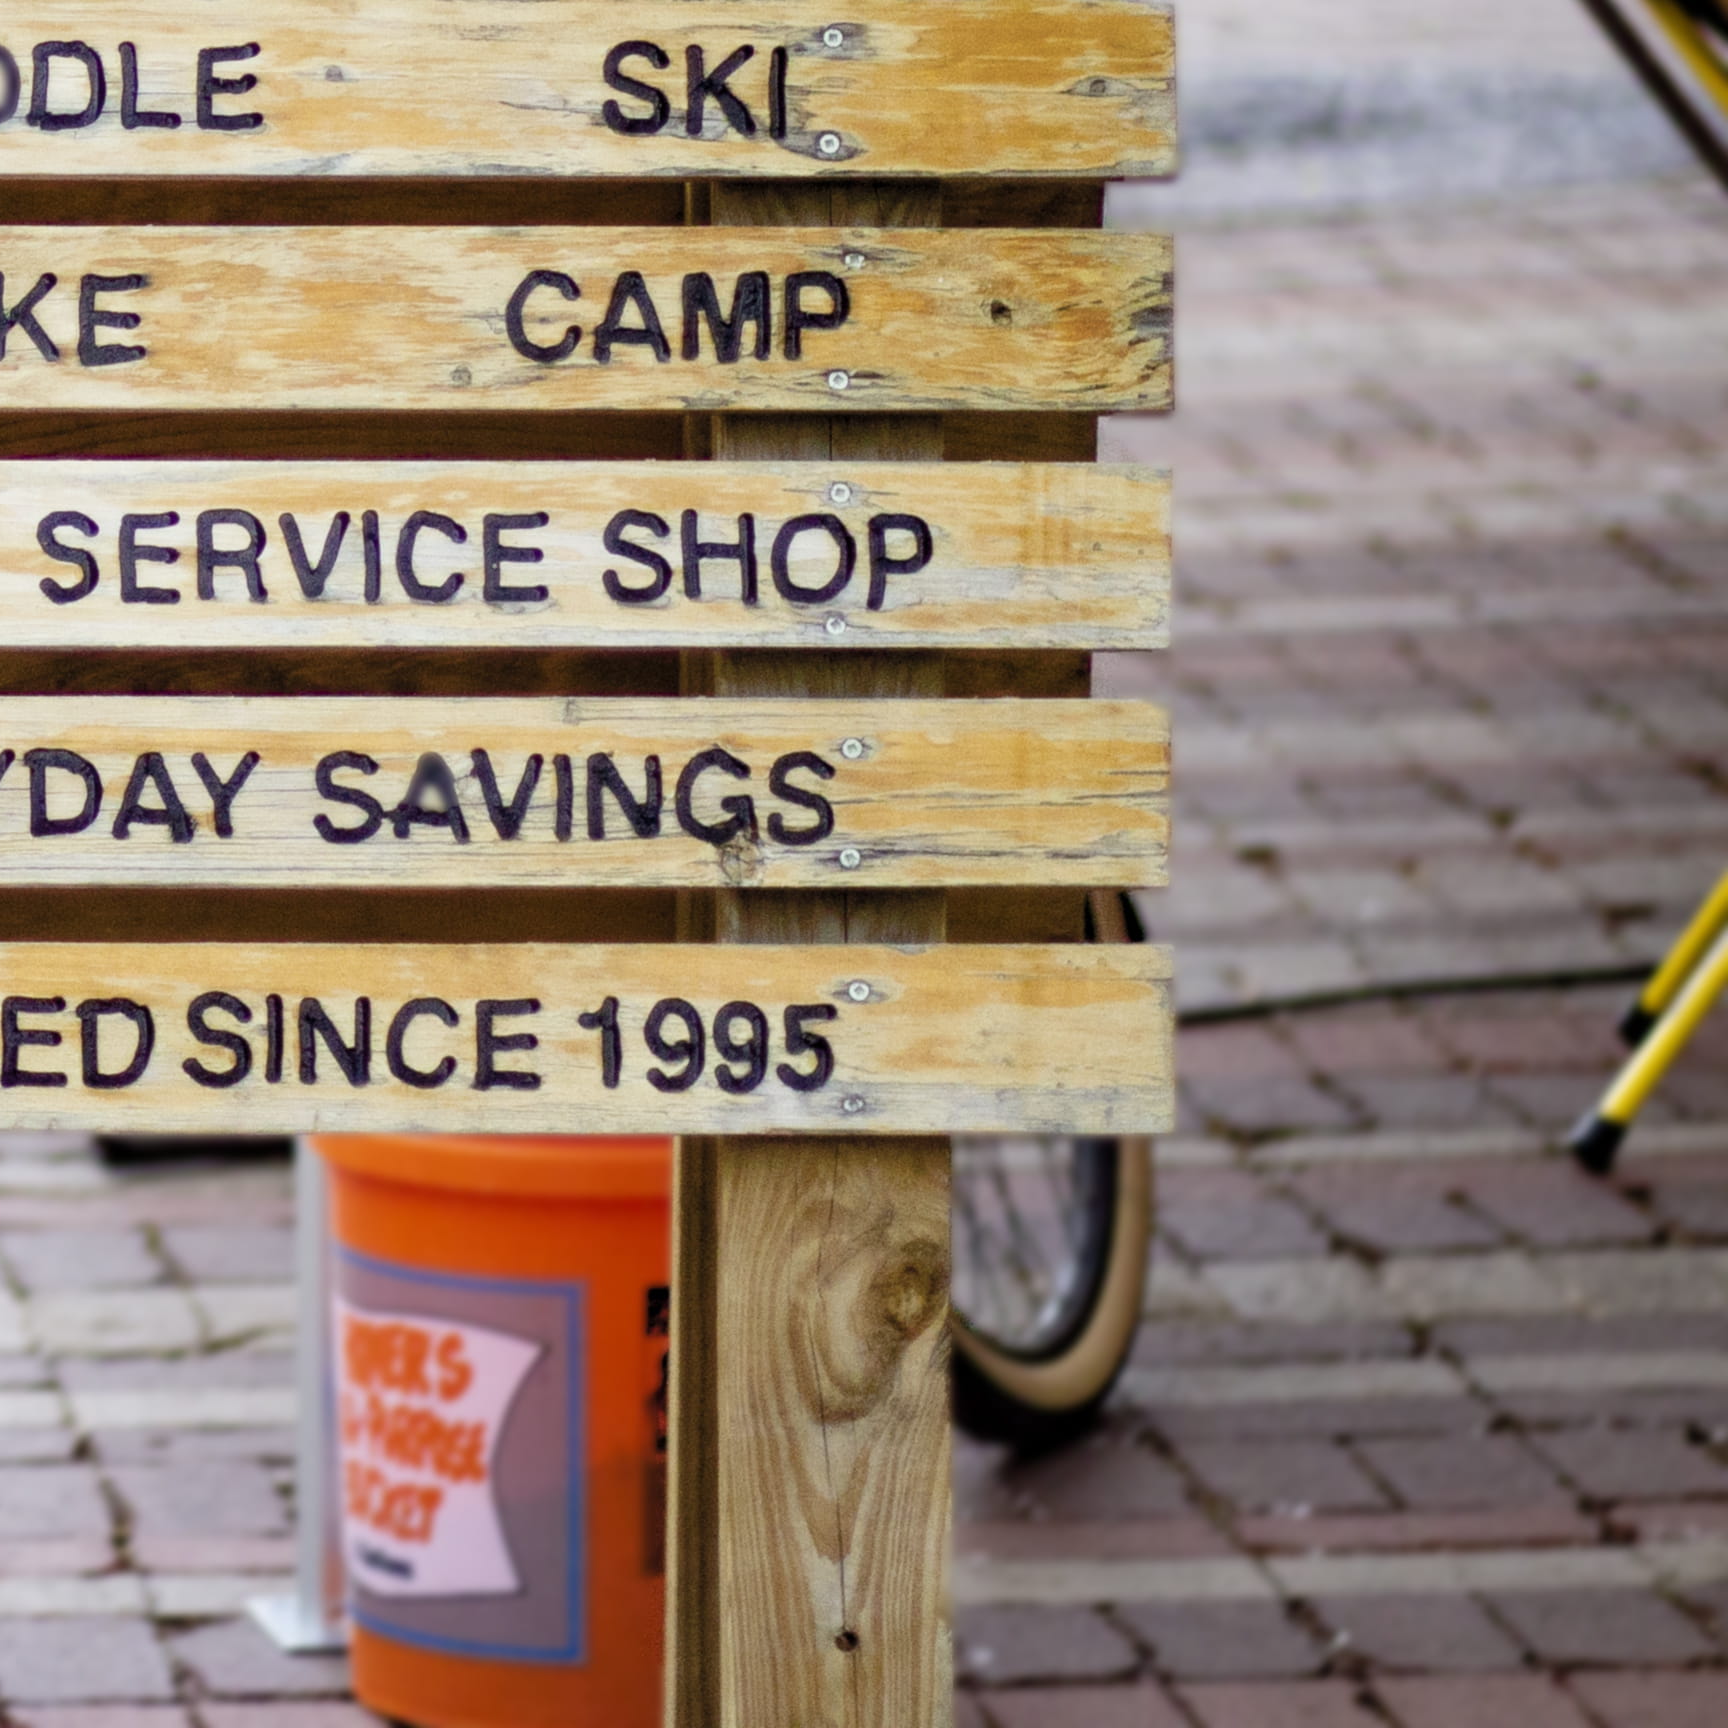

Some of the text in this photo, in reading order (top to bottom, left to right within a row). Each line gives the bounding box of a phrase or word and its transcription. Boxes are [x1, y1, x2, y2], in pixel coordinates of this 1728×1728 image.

[602, 41, 788, 142] SKI
[506, 270, 851, 365] CAMP
[37, 509, 549, 603] SERVICE
[603, 509, 933, 611] SHOP
[314, 748, 835, 845] SAVINGS
[183, 991, 541, 1091] SINCE
[578, 997, 837, 1094] 1995
